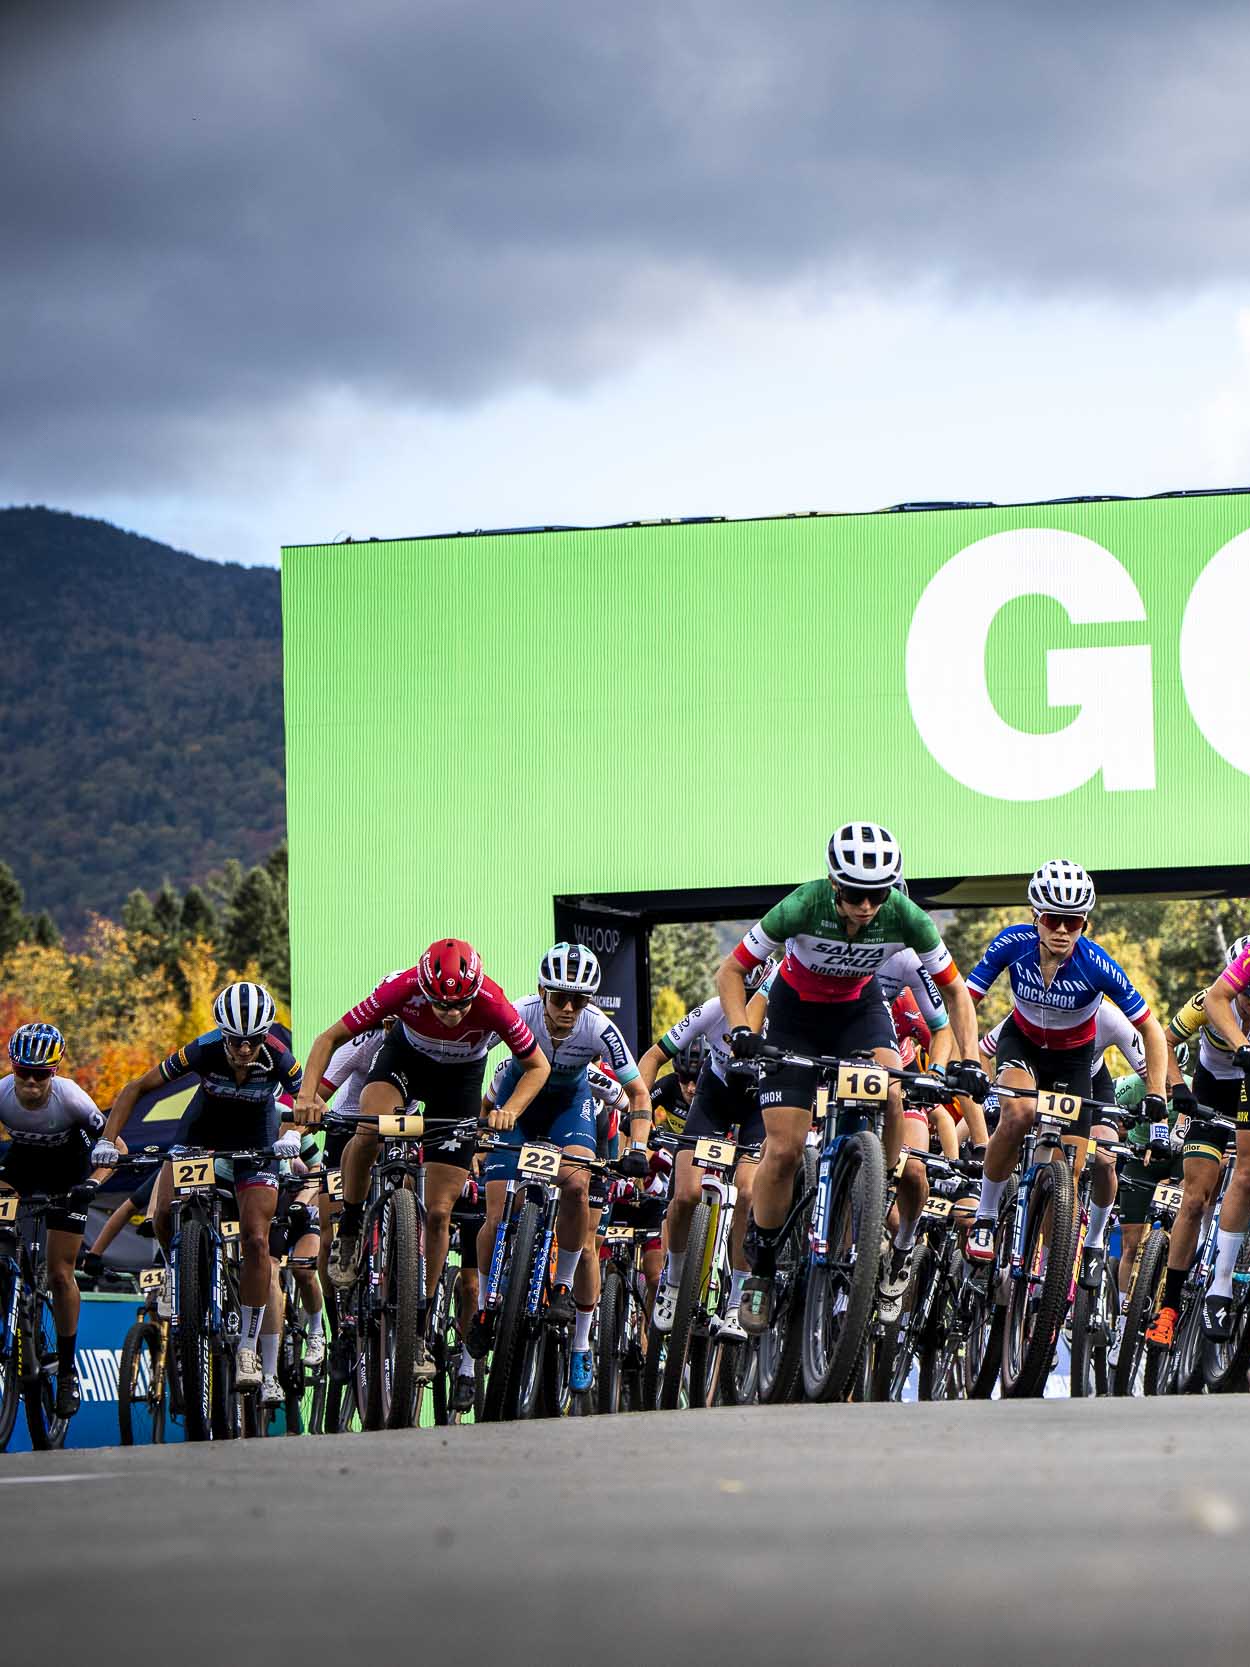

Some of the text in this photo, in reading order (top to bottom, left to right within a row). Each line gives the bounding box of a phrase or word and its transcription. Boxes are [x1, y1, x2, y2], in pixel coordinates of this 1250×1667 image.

[574, 923, 620, 953] WHOOP
[988, 931, 1038, 953] CANYON
[812, 942, 885, 959] SANTA
[824, 956, 884, 969] CRUZ
[1089, 949, 1128, 990] CANYON
[921, 969, 942, 1004] MAVIC
[1016, 962, 1088, 992] CANYON
[1017, 982, 1076, 1009] ROCKSHOX
[605, 1032, 626, 1067] MAVIC
[846, 1073, 881, 1095] 16
[760, 1090, 782, 1104] SHOX
[1045, 1093, 1075, 1115] 10
[395, 1116, 405, 1132] 1
[524, 1150, 557, 1172] 22
[707, 1144, 722, 1159] 5
[179, 1163, 209, 1183] 27
[926, 1199, 947, 1213] 44
[608, 1228, 629, 1236] 37
[143, 1271, 163, 1285] 41
